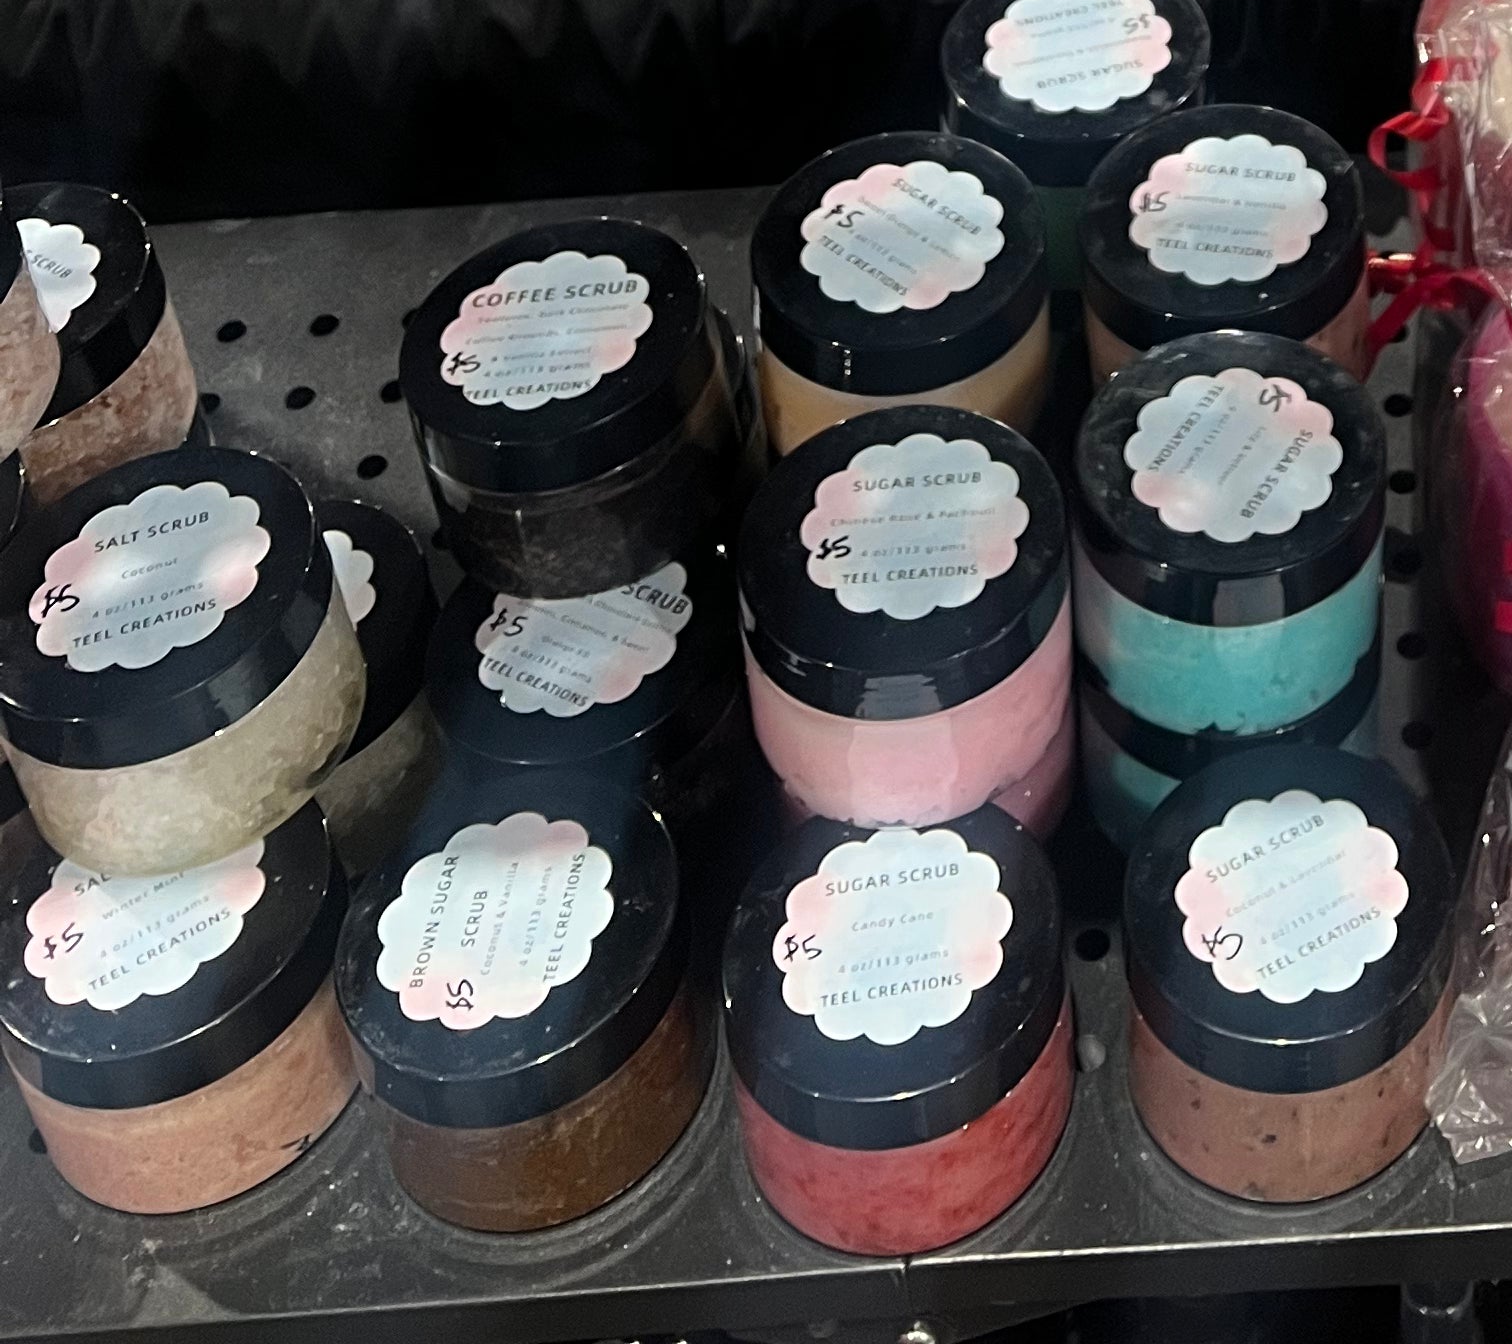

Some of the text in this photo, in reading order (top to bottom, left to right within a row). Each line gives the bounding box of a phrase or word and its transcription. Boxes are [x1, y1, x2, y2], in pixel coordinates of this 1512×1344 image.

[1185, 162, 1297, 182] SUGAR SCRUB
[823, 203, 865, 228] $5
[892, 178, 938, 209] SUGAR
[938, 205, 982, 236] SCRUB
[1139, 190, 1171, 213] $5
[31, 254, 73, 279] SCRUB
[472, 279, 639, 309] COFFEE SCRUB
[446, 351, 482, 376] $5
[505, 379, 593, 397] CREATIONS
[1196, 385, 1225, 409] TEEL
[1147, 412, 1202, 473] CREATIONS
[1274, 429, 1313, 473] SUGAR
[852, 471, 982, 492] SUGAR SCRUB
[1241, 474, 1280, 519] SCRUB
[94, 511, 210, 553] SALT SCRUB
[815, 535, 851, 560] $5
[121, 558, 178, 579] Coconut
[841, 564, 978, 584] TEEL CREATIONS
[41, 583, 80, 618] $5
[160, 581, 204, 601] grams
[620, 582, 690, 615] SCRUB
[72, 598, 217, 649] TEEL CREATIONS
[490, 608, 528, 637] $5
[485, 657, 512, 678] TEEL
[516, 672, 589, 708] CREATIONS
[1206, 814, 1325, 884] SUGAR SCRUB
[74, 872, 112, 897] SAL
[101, 871, 185, 921] Winter Mint
[536, 865, 553, 906] grams
[825, 863, 960, 897] SUGAR SCRUB
[166, 895, 211, 924] grams
[409, 854, 460, 988] BROWN SUGAR
[460, 890, 488, 948] SCRUB
[480, 862, 519, 976] Coconut & Vanilla
[542, 852, 586, 982] TEEL CREATIONS
[851, 911, 934, 933] Candy Cane
[43, 922, 84, 960] $5
[88, 906, 231, 991] TEEL CREATIONS
[783, 934, 822, 963] $5
[905, 949, 949, 966] grams
[1202, 926, 1243, 961] $5
[1256, 906, 1381, 980] TEEL CREATIONS
[445, 978, 474, 1012] $5
[820, 972, 964, 1008] TEEL CREATIONS
